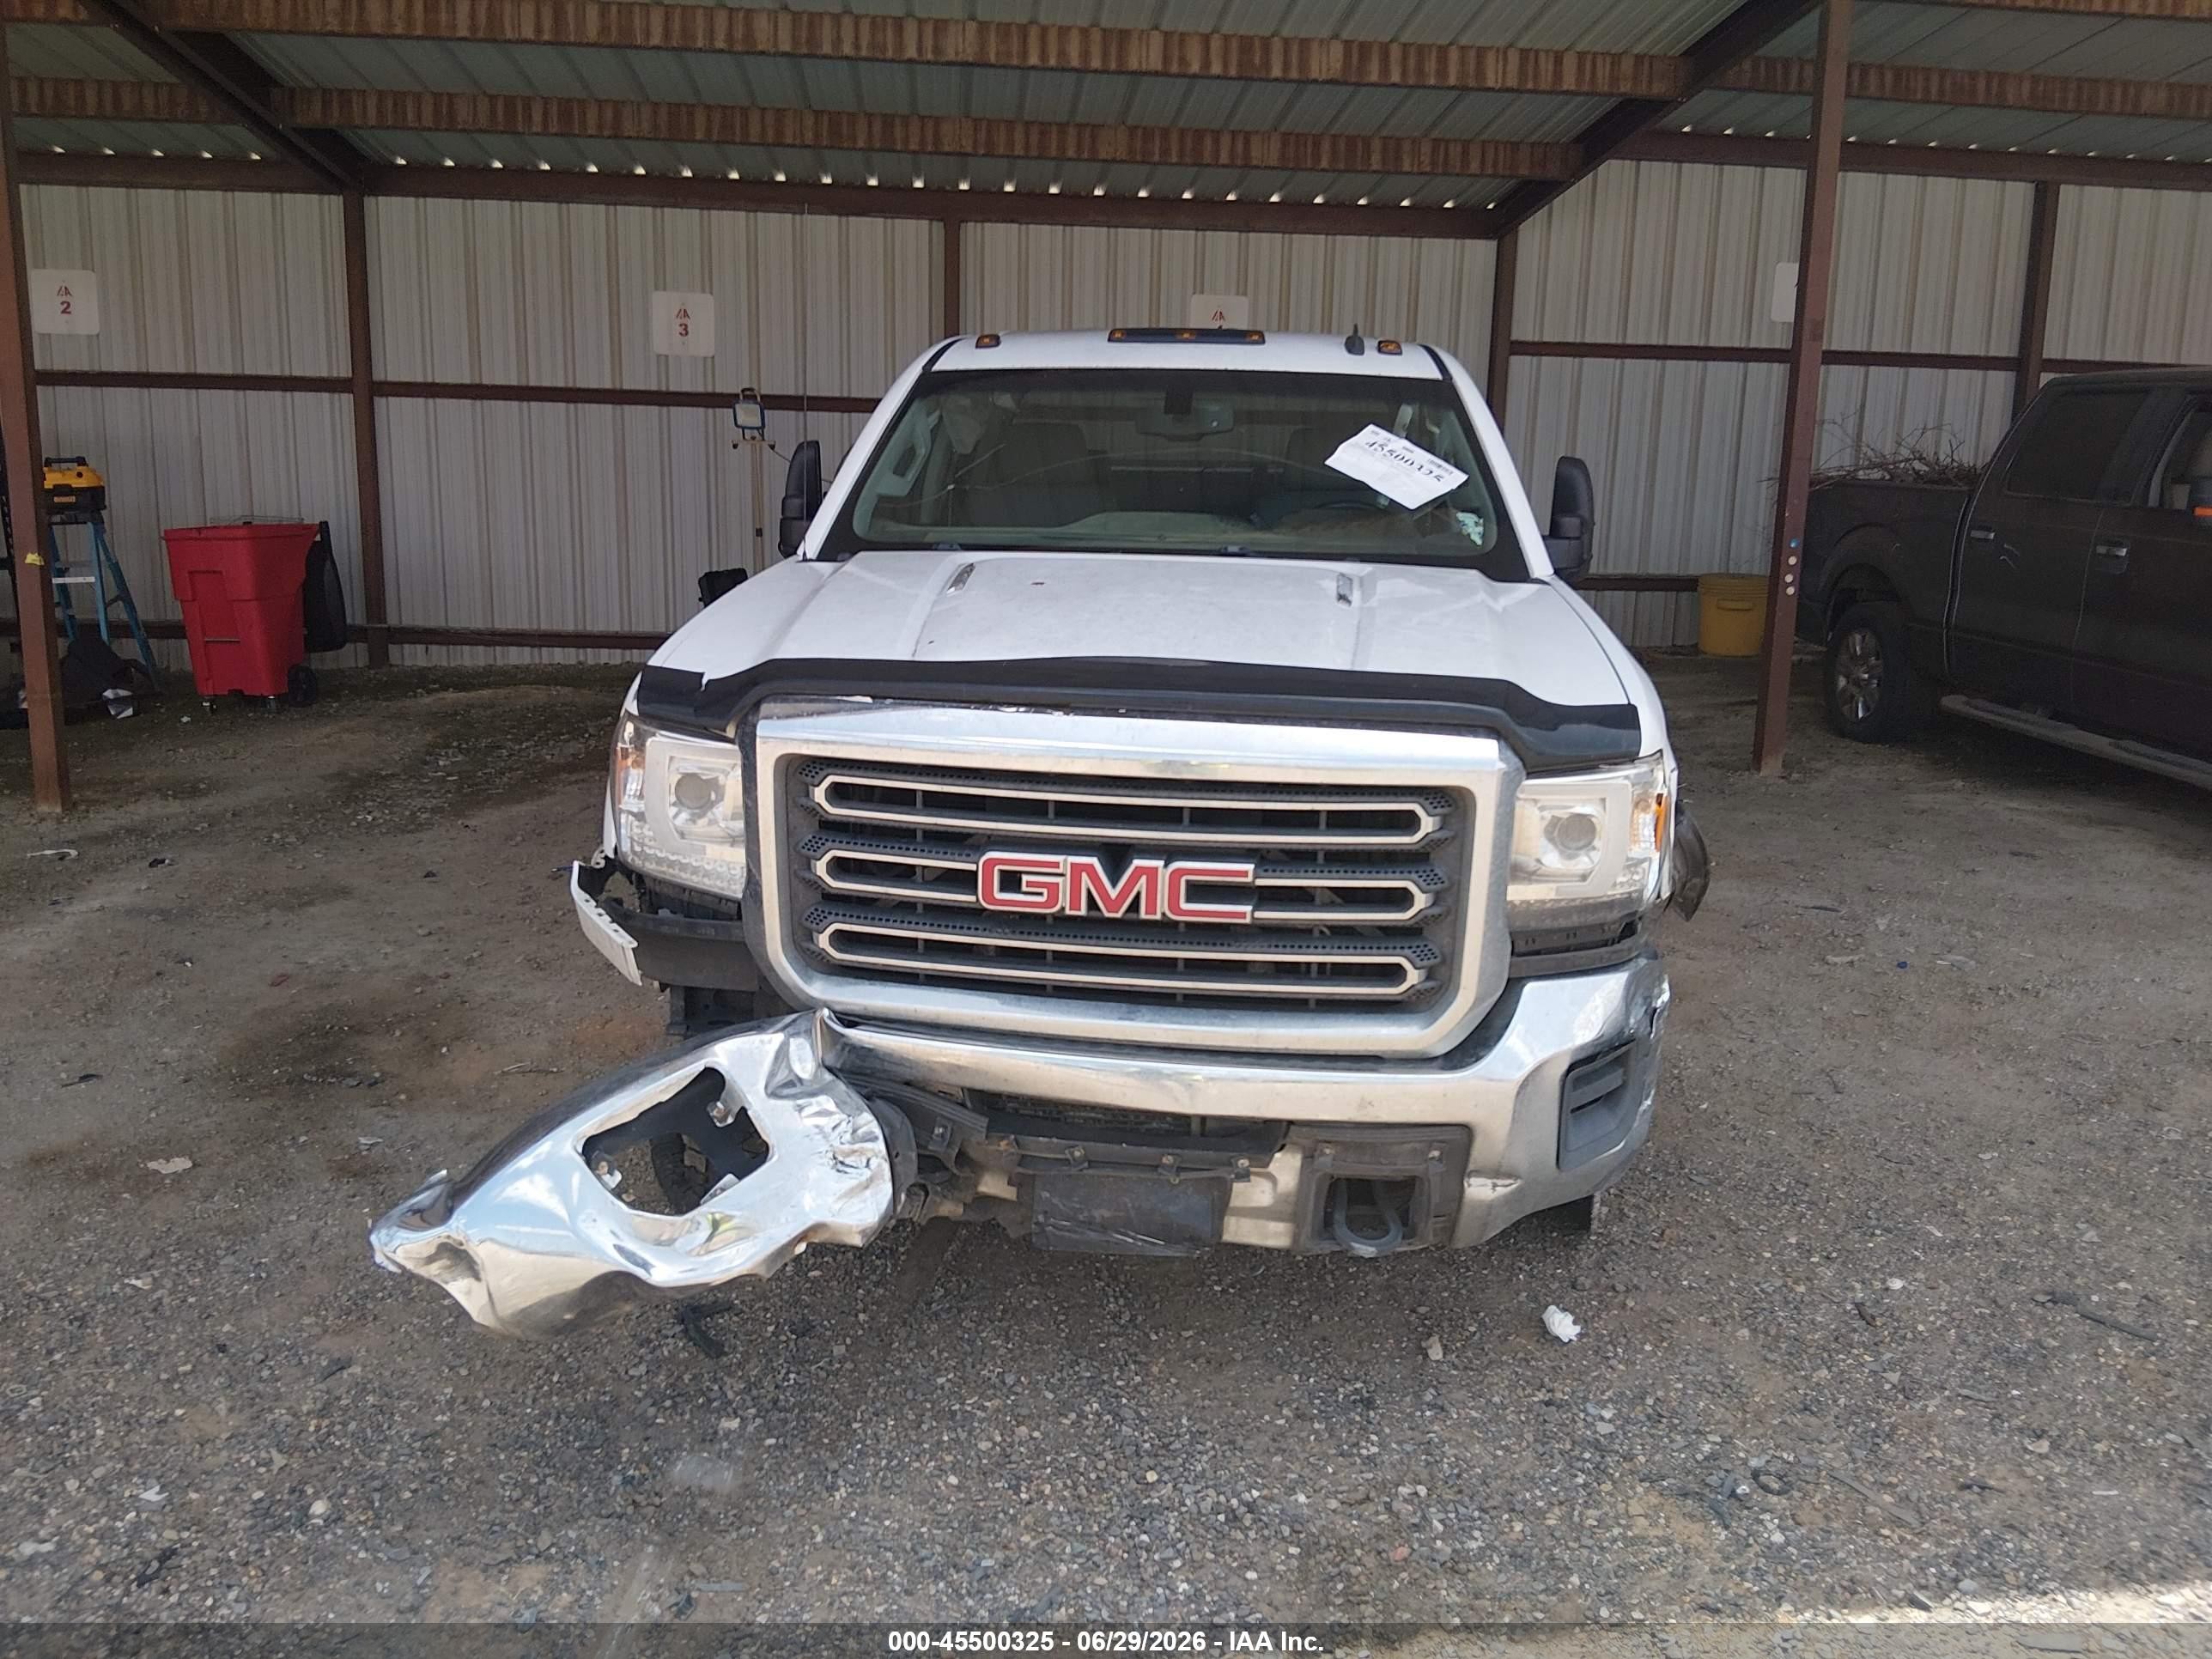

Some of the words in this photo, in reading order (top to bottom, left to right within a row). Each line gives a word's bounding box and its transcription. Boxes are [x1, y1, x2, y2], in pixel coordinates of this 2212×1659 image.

[60, 301, 72, 314] 2
[678, 322, 690, 337] 3
[977, 851, 1255, 924] GMC
